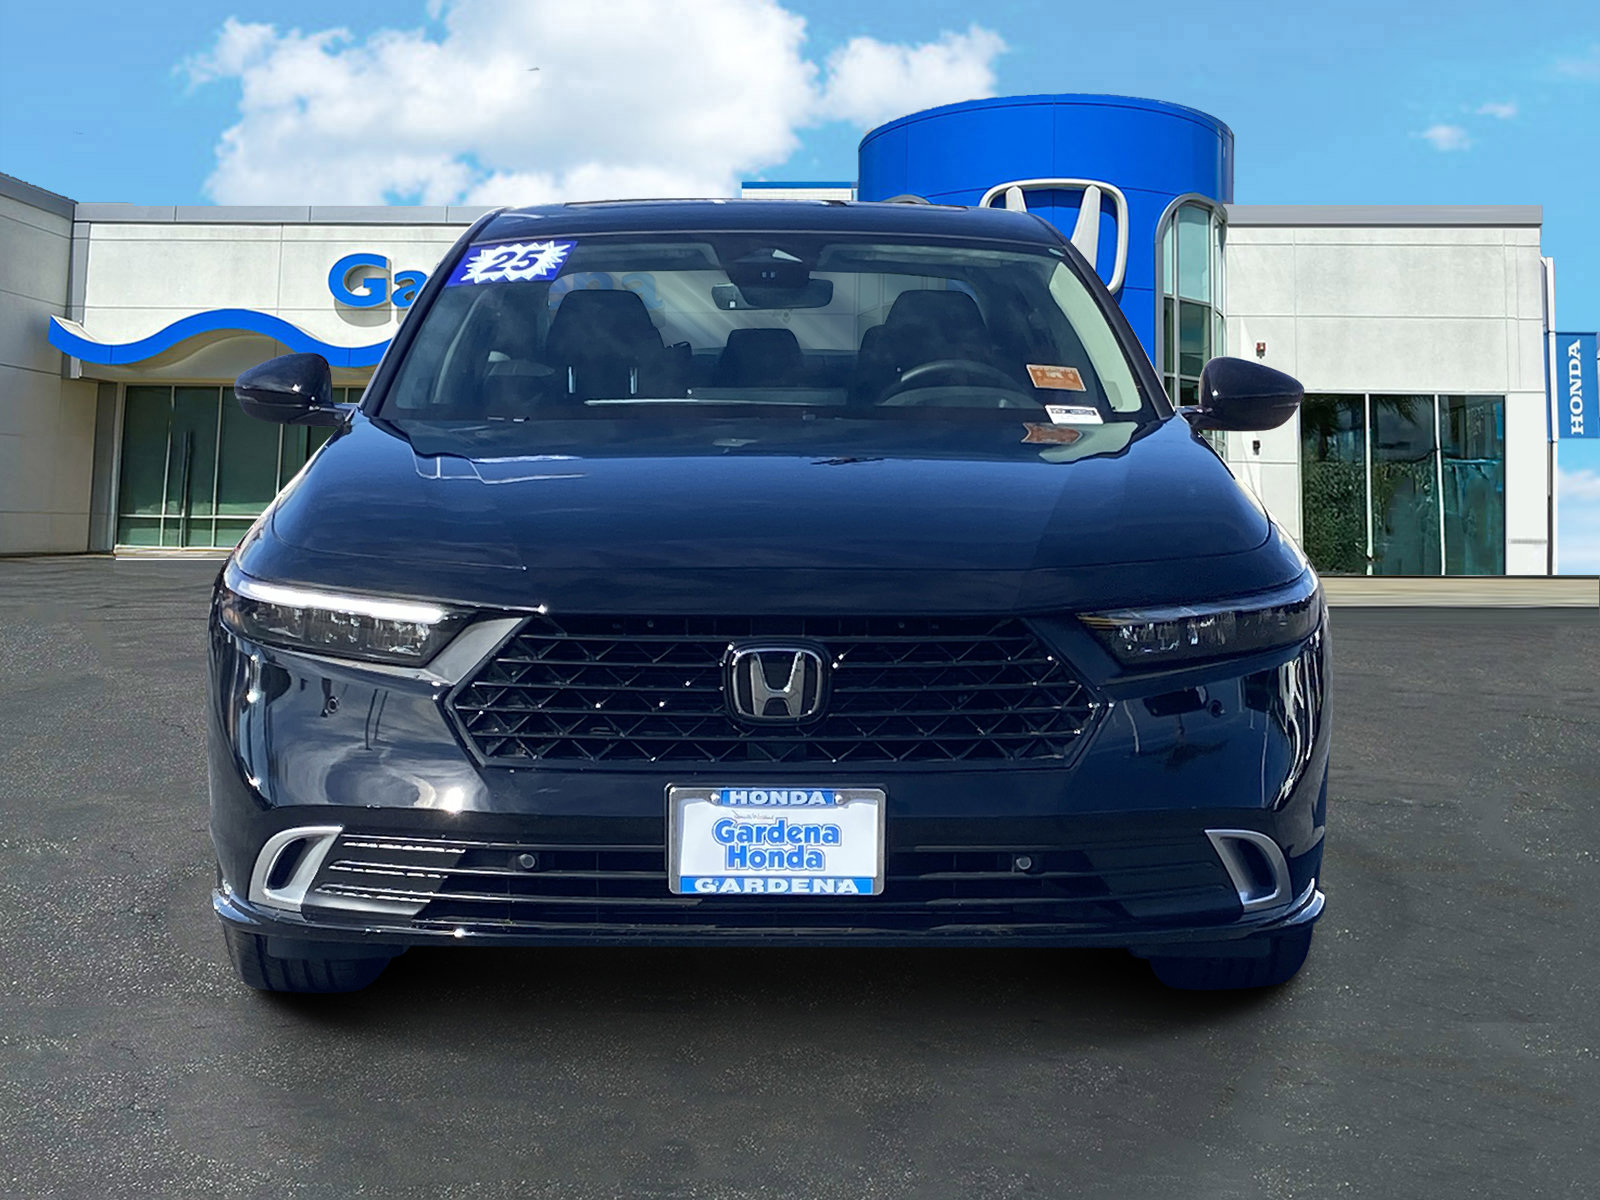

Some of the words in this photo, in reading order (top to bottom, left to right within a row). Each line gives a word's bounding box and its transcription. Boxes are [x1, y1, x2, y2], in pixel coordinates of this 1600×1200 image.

[479, 249, 547, 274] 25
[1567, 338, 1584, 435] HONDA
[729, 790, 827, 806] HONDA
[714, 818, 842, 845] Gardena
[727, 844, 824, 869] Honda
[693, 877, 860, 894] GARDENA
